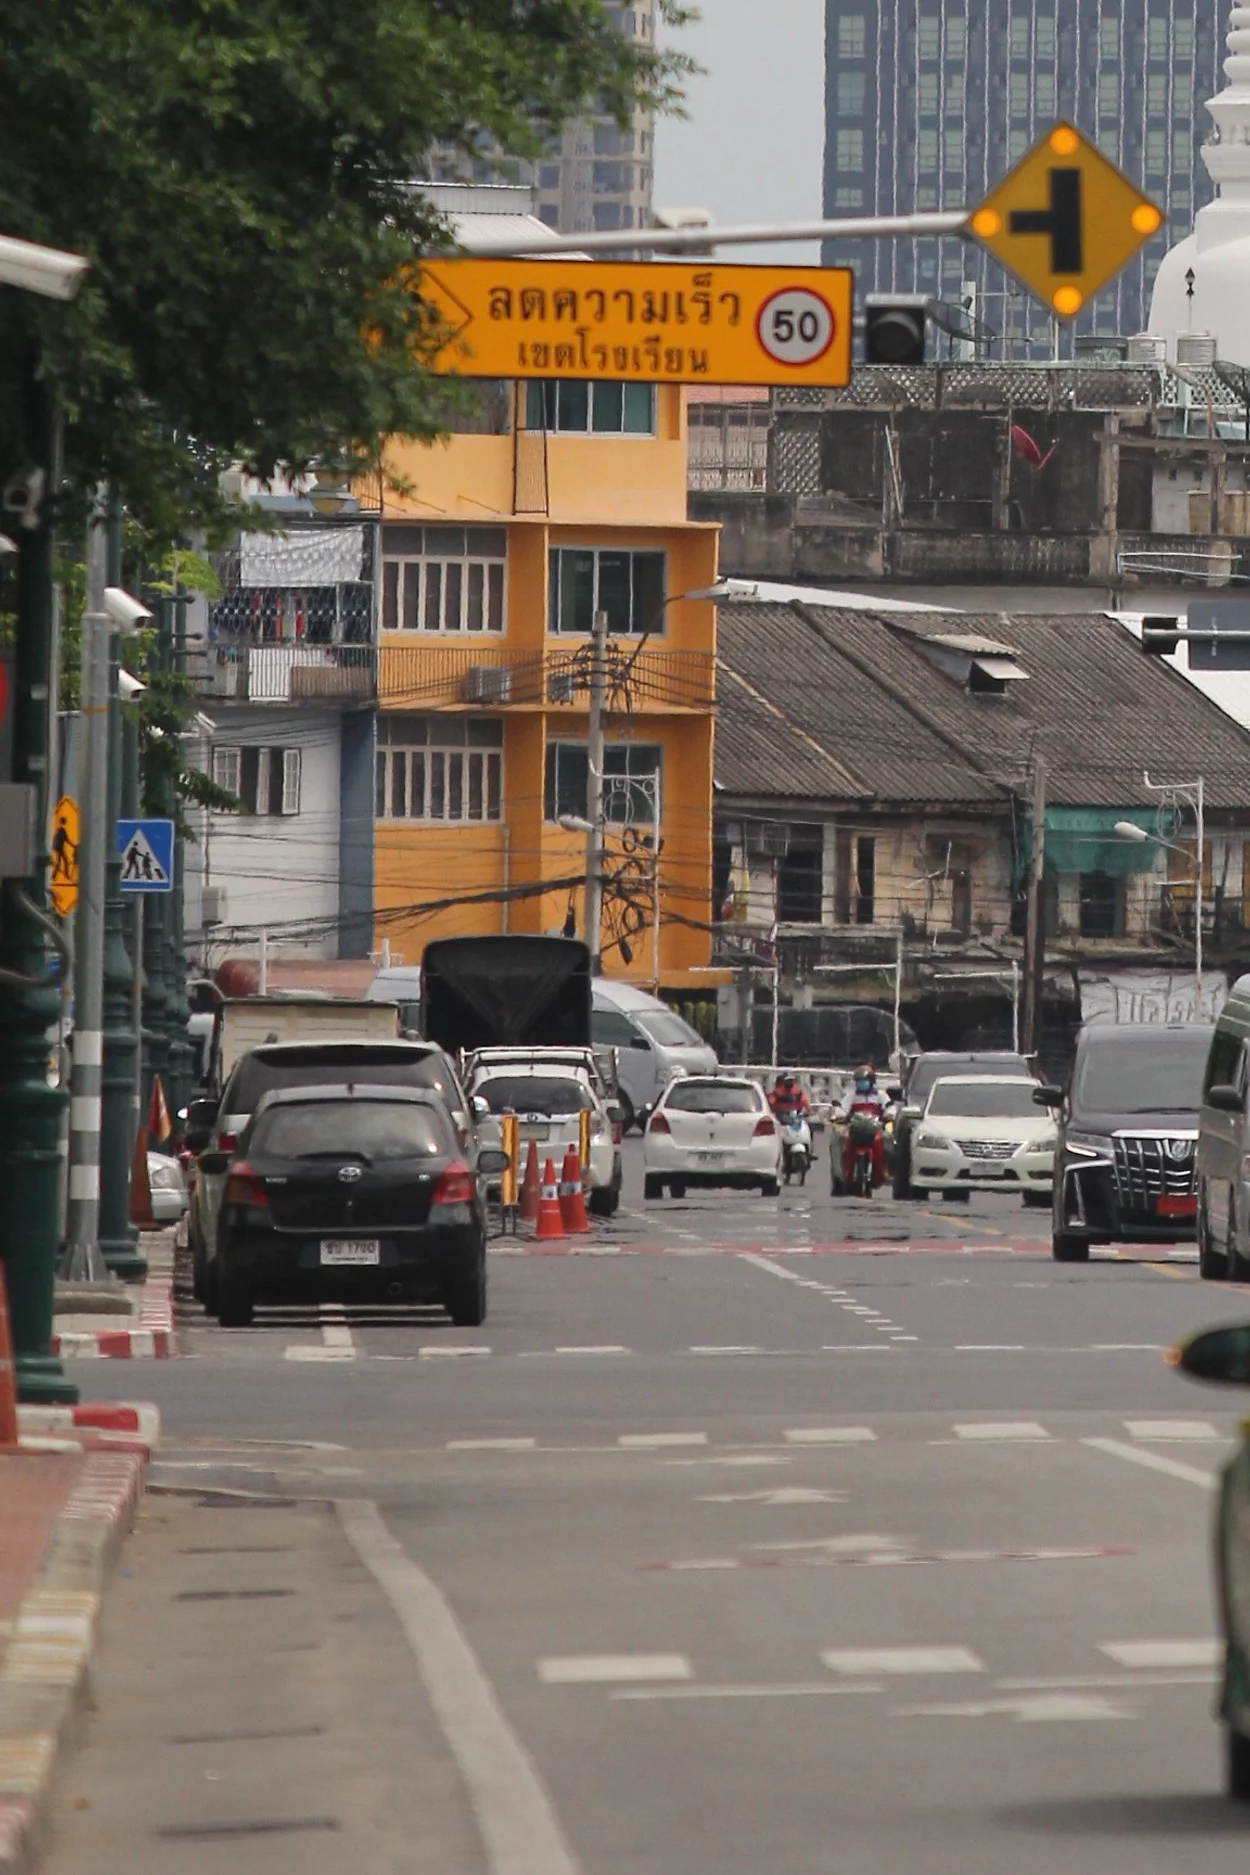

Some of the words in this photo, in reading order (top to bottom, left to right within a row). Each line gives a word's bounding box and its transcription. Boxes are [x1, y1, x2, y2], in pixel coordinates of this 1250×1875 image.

[488, 271, 741, 327] ลดความเร็ว
[772, 310, 820, 343] 50
[517, 327, 710, 374] เขตโรงเรียน
